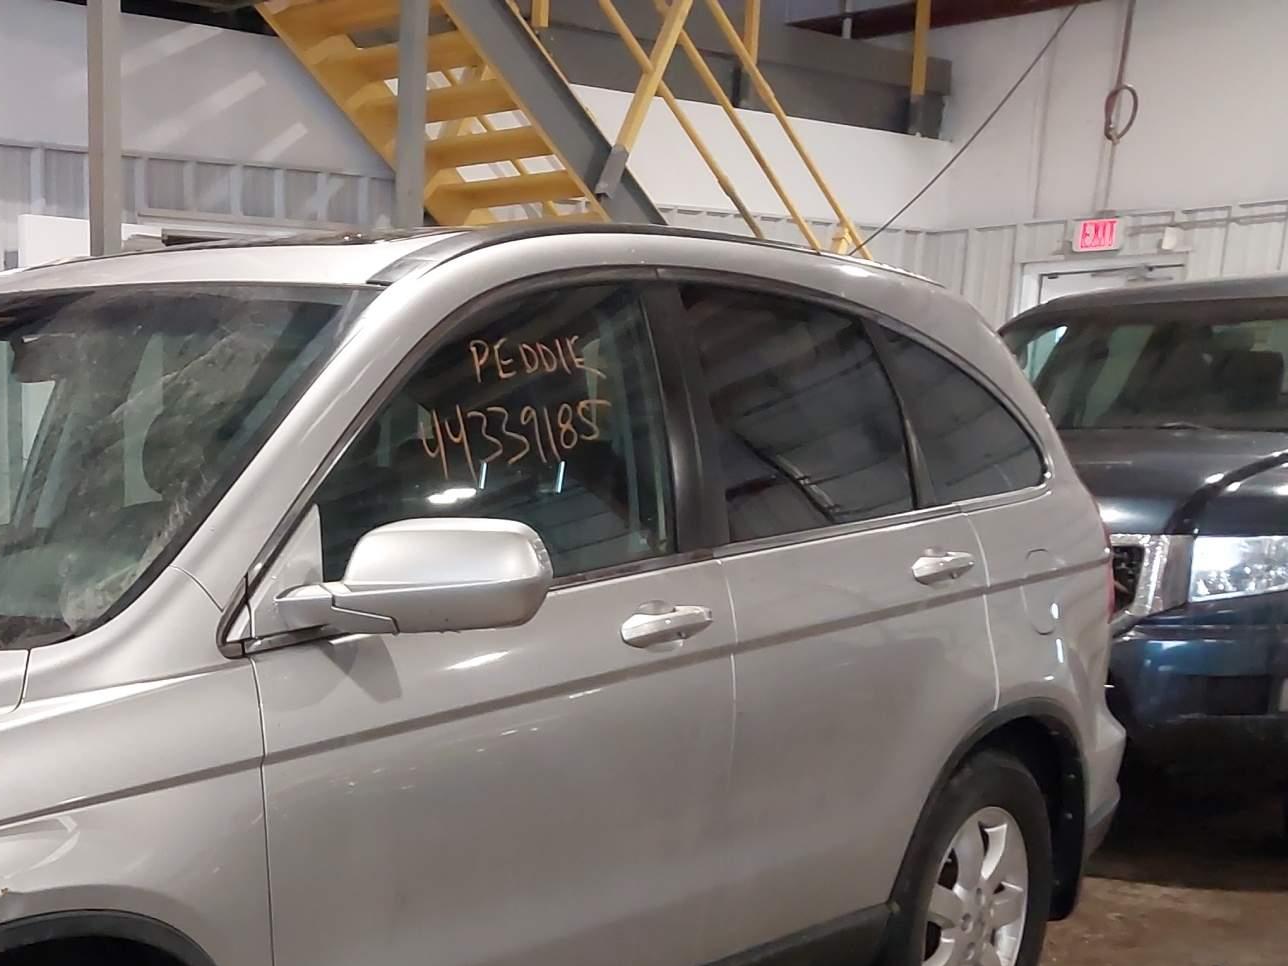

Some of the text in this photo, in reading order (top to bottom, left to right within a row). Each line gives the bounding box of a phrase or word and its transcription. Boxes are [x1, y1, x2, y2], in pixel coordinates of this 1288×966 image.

[1081, 221, 1116, 248] EXIT
[469, 336, 607, 383] PEDDIE
[420, 399, 612, 480] 44339185
